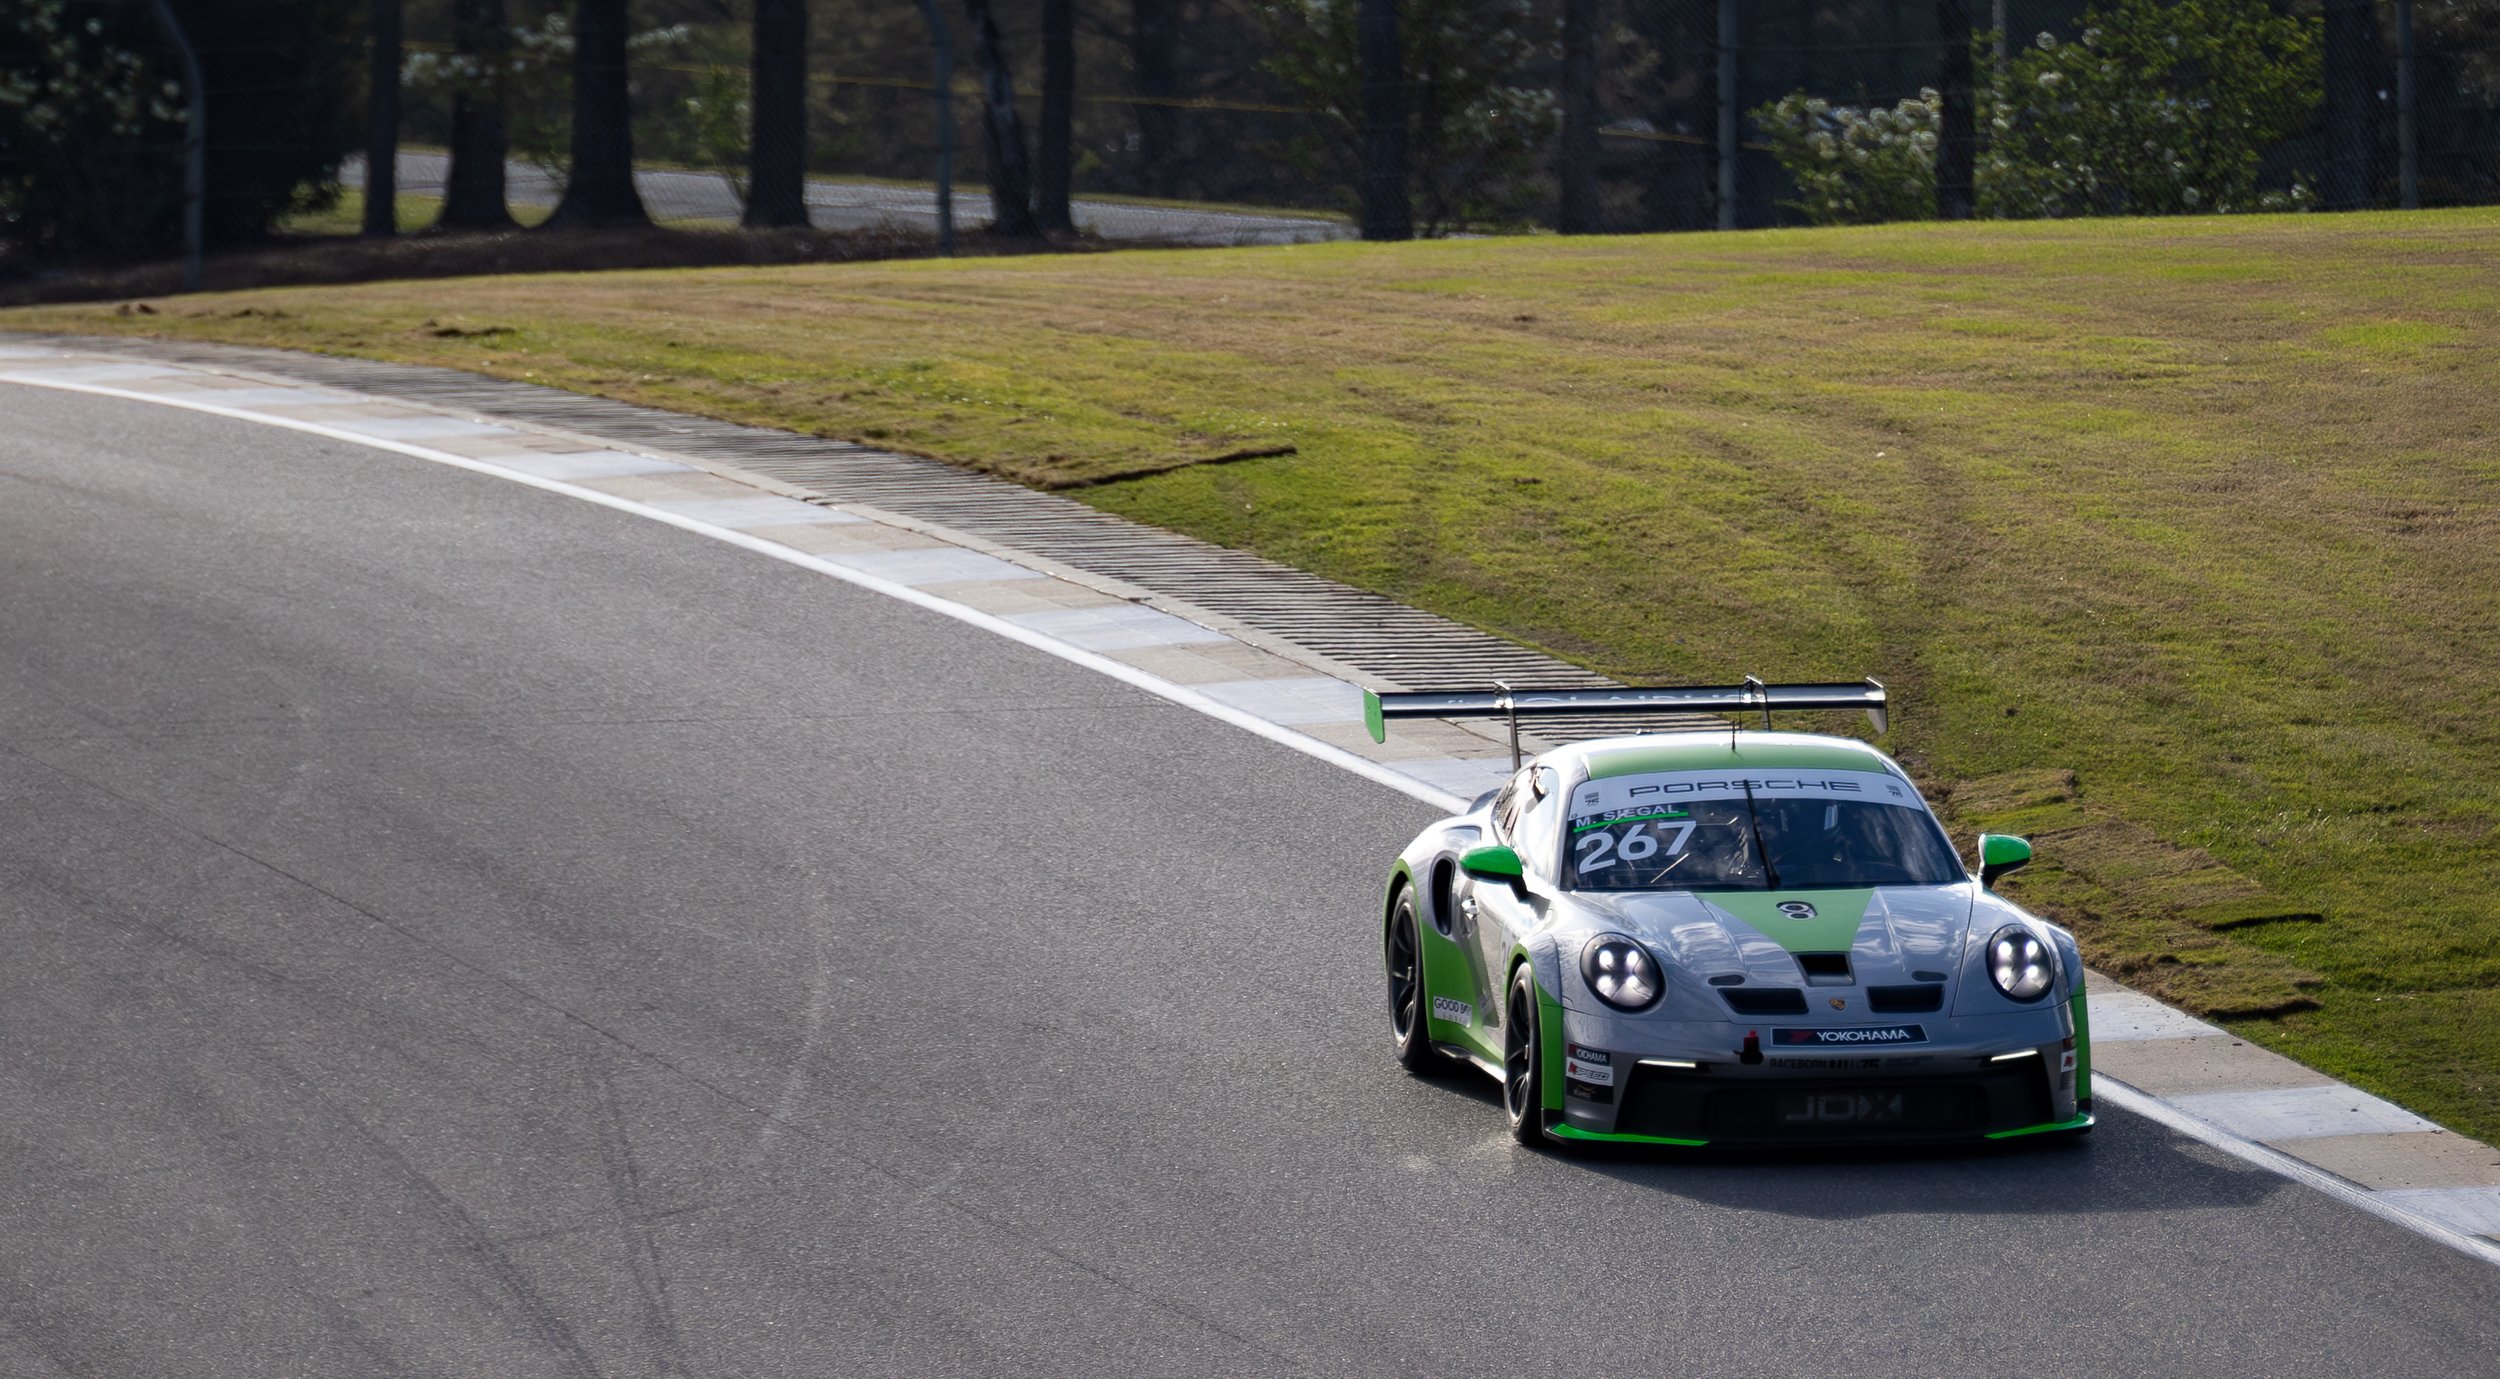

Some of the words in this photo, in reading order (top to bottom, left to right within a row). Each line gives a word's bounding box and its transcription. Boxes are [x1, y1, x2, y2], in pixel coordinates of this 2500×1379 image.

[1629, 779, 1861, 798] PORSCHE
[1575, 816, 1597, 828] M.
[1603, 804, 1679, 822] SIEGAL
[1575, 820, 1697, 875] 267
[1816, 1029, 1911, 1042] YOKOHAMA
[1576, 1048, 1607, 1063] OOHAMA
